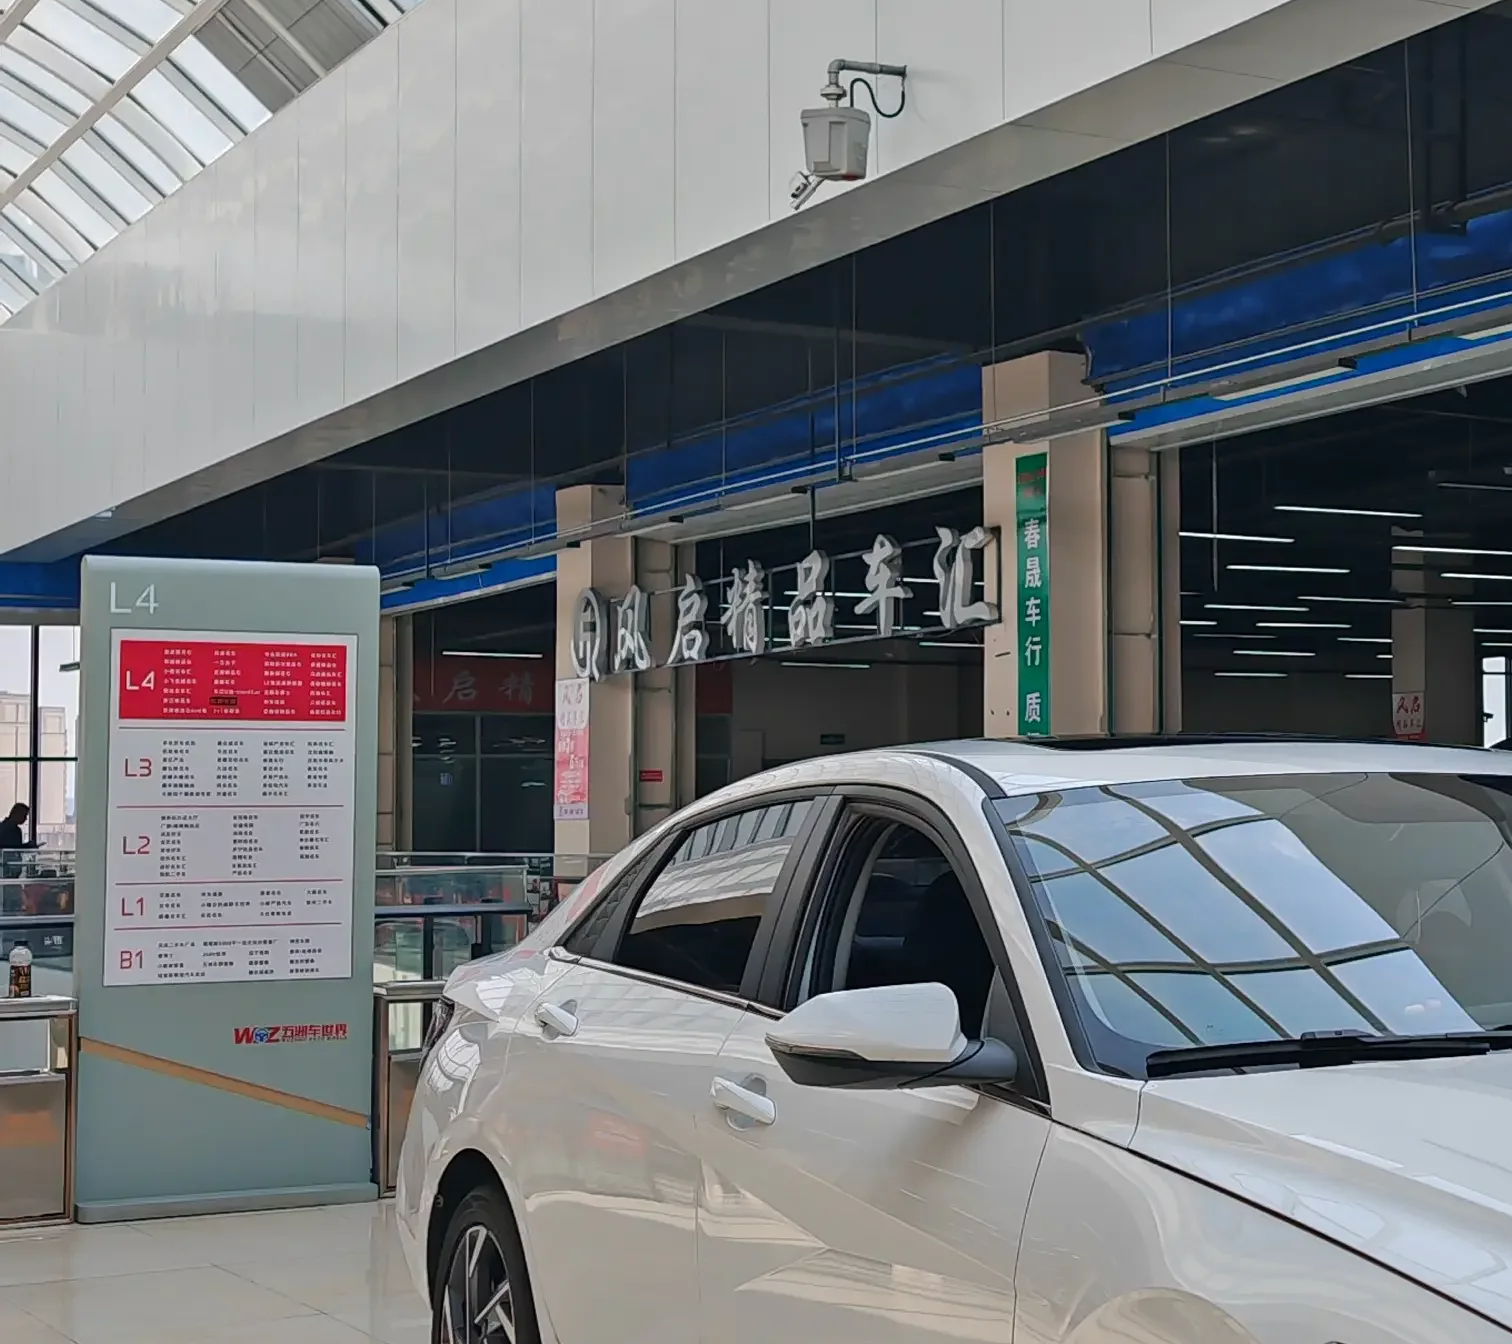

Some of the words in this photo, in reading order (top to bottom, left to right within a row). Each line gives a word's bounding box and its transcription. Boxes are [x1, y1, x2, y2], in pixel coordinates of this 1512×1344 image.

[109, 580, 160, 617] L4
[613, 524, 1001, 673] 风启精品车汇
[1023, 517, 1043, 667] 春晟车行
[125, 669, 156, 691] L4
[1023, 690, 1043, 735] 质
[124, 757, 153, 778] L3
[121, 835, 151, 856] L2
[121, 897, 147, 917] L1
[119, 949, 144, 970] B1
